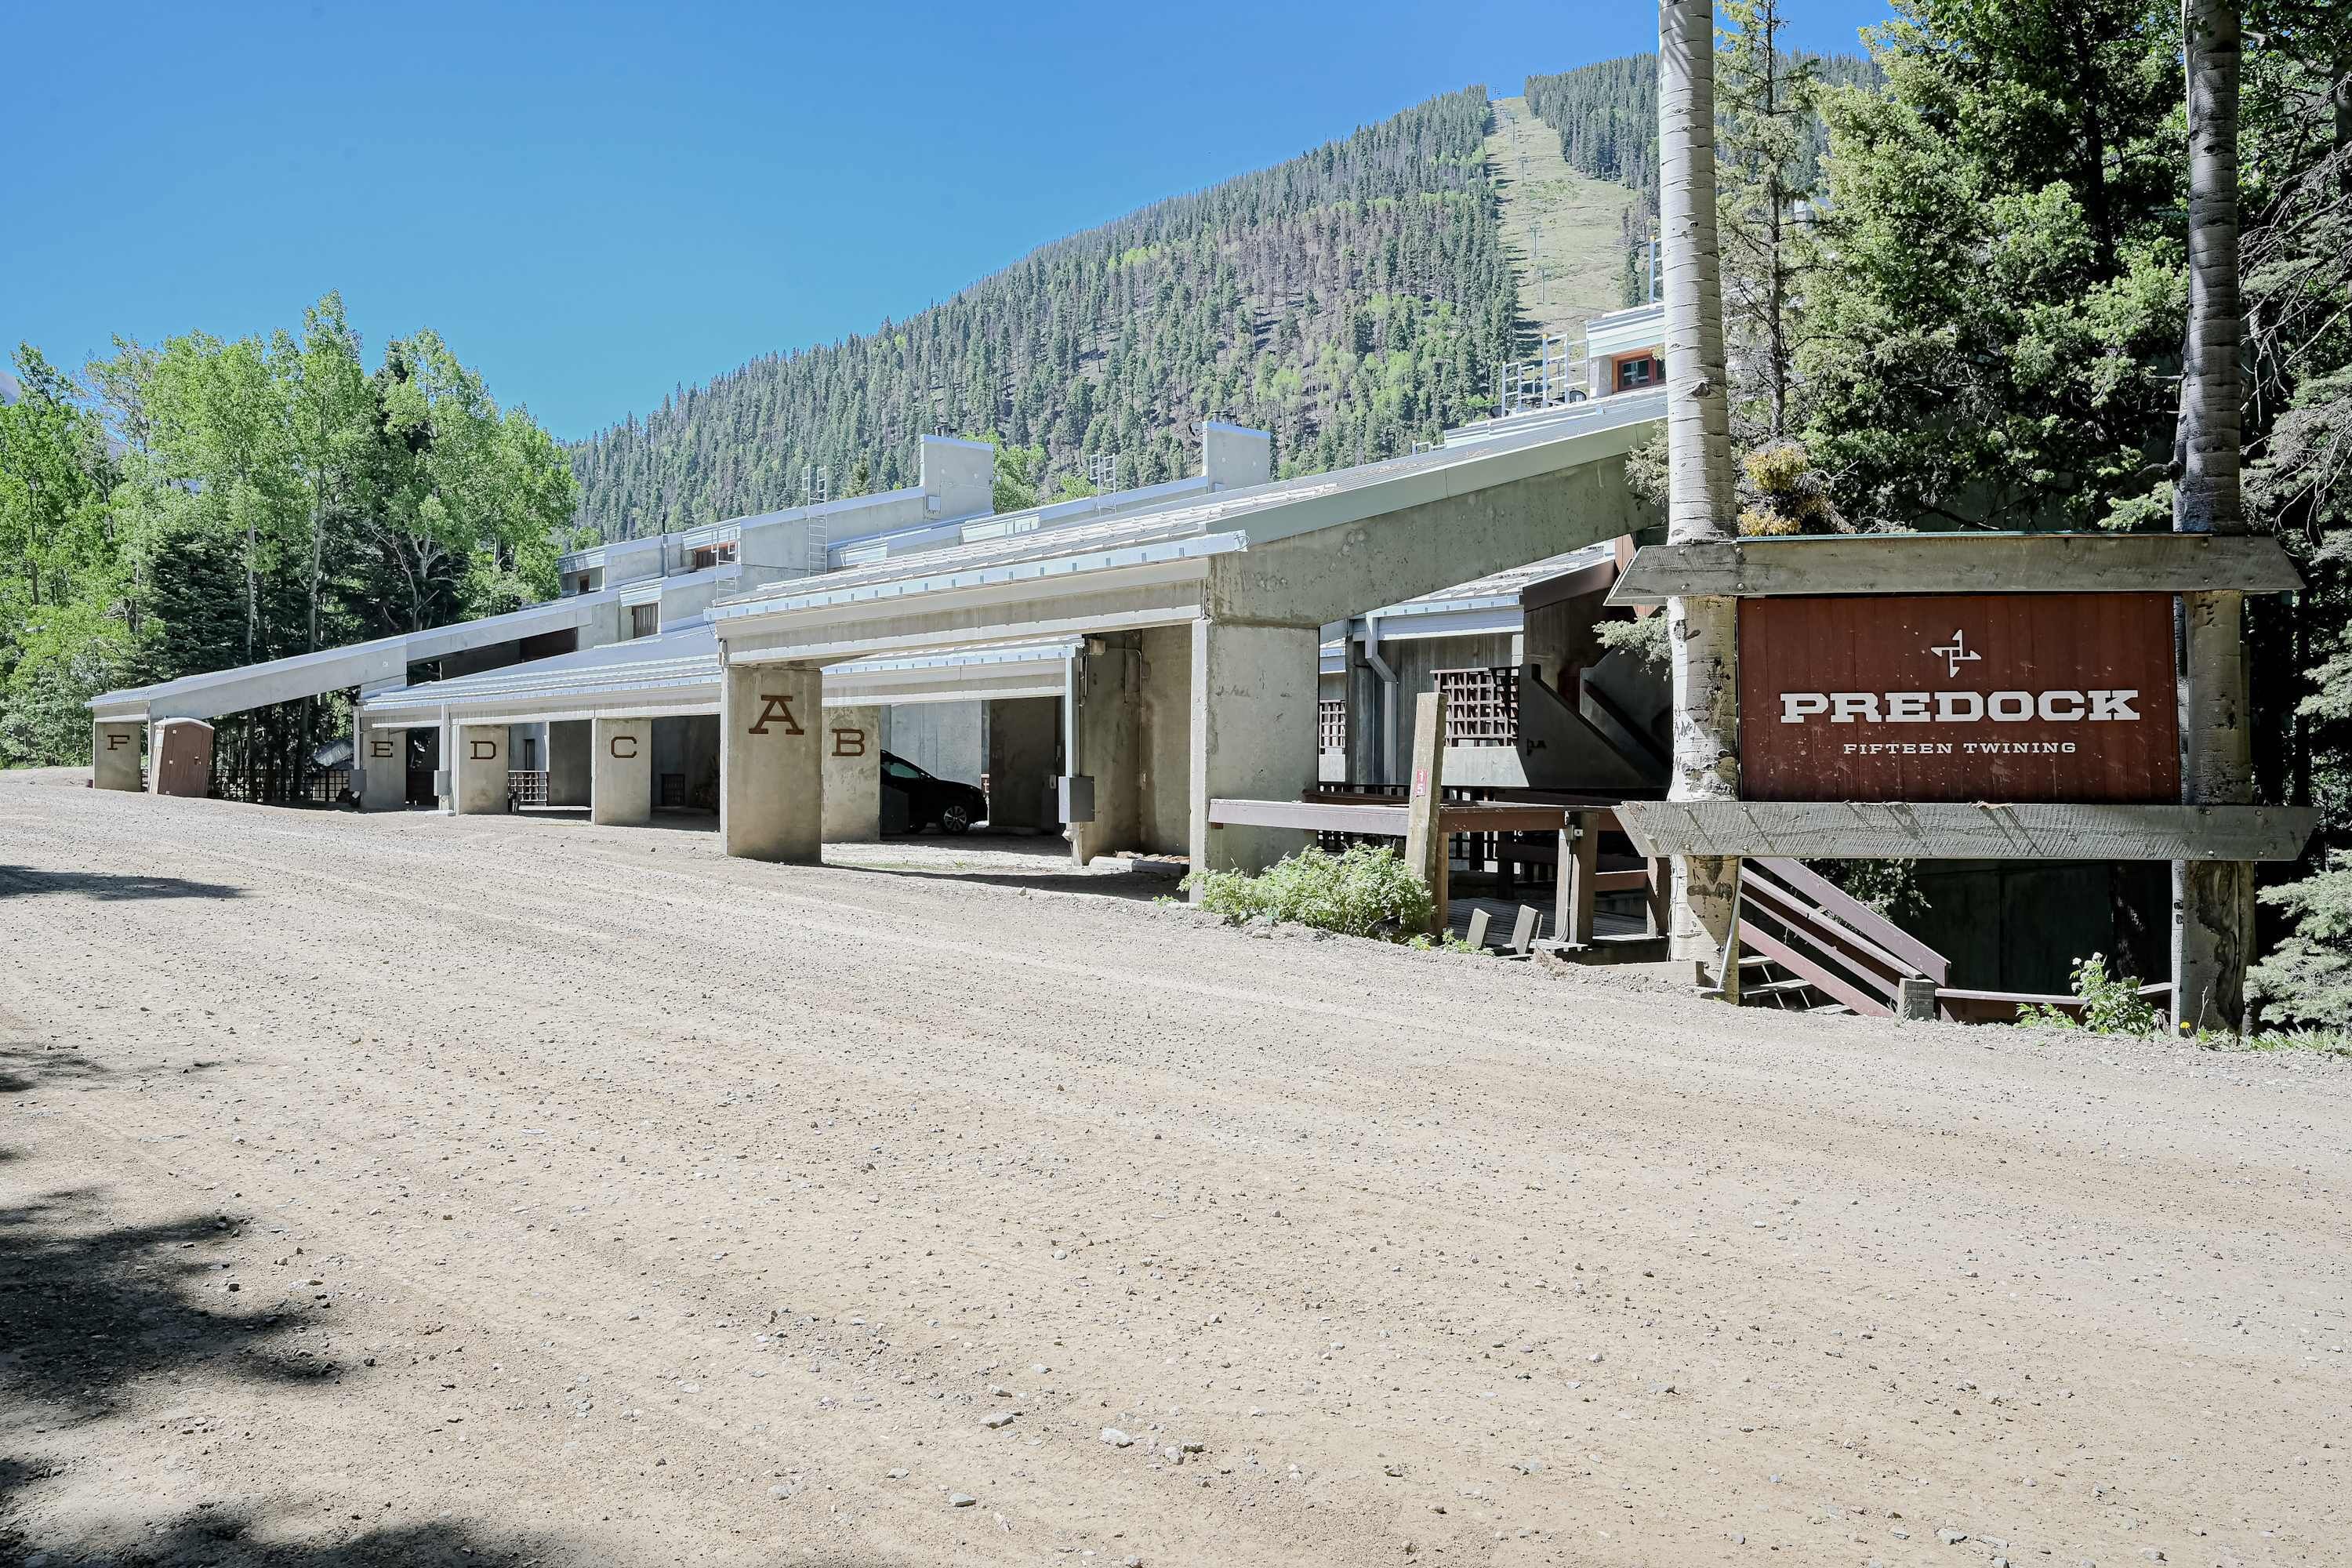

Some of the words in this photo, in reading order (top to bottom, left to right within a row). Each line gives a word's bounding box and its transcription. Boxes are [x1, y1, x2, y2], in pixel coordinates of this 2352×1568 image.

[749, 695, 804, 735] A
[1780, 690, 2140, 724] PREDOCK
[107, 735, 130, 751] F
[370, 739, 394, 757] E
[470, 740, 497, 760] D
[611, 735, 637, 758] C
[830, 728, 866, 757] B
[1843, 743, 1953, 755] FIFTEEN
[1963, 742, 2077, 753] TWINING
